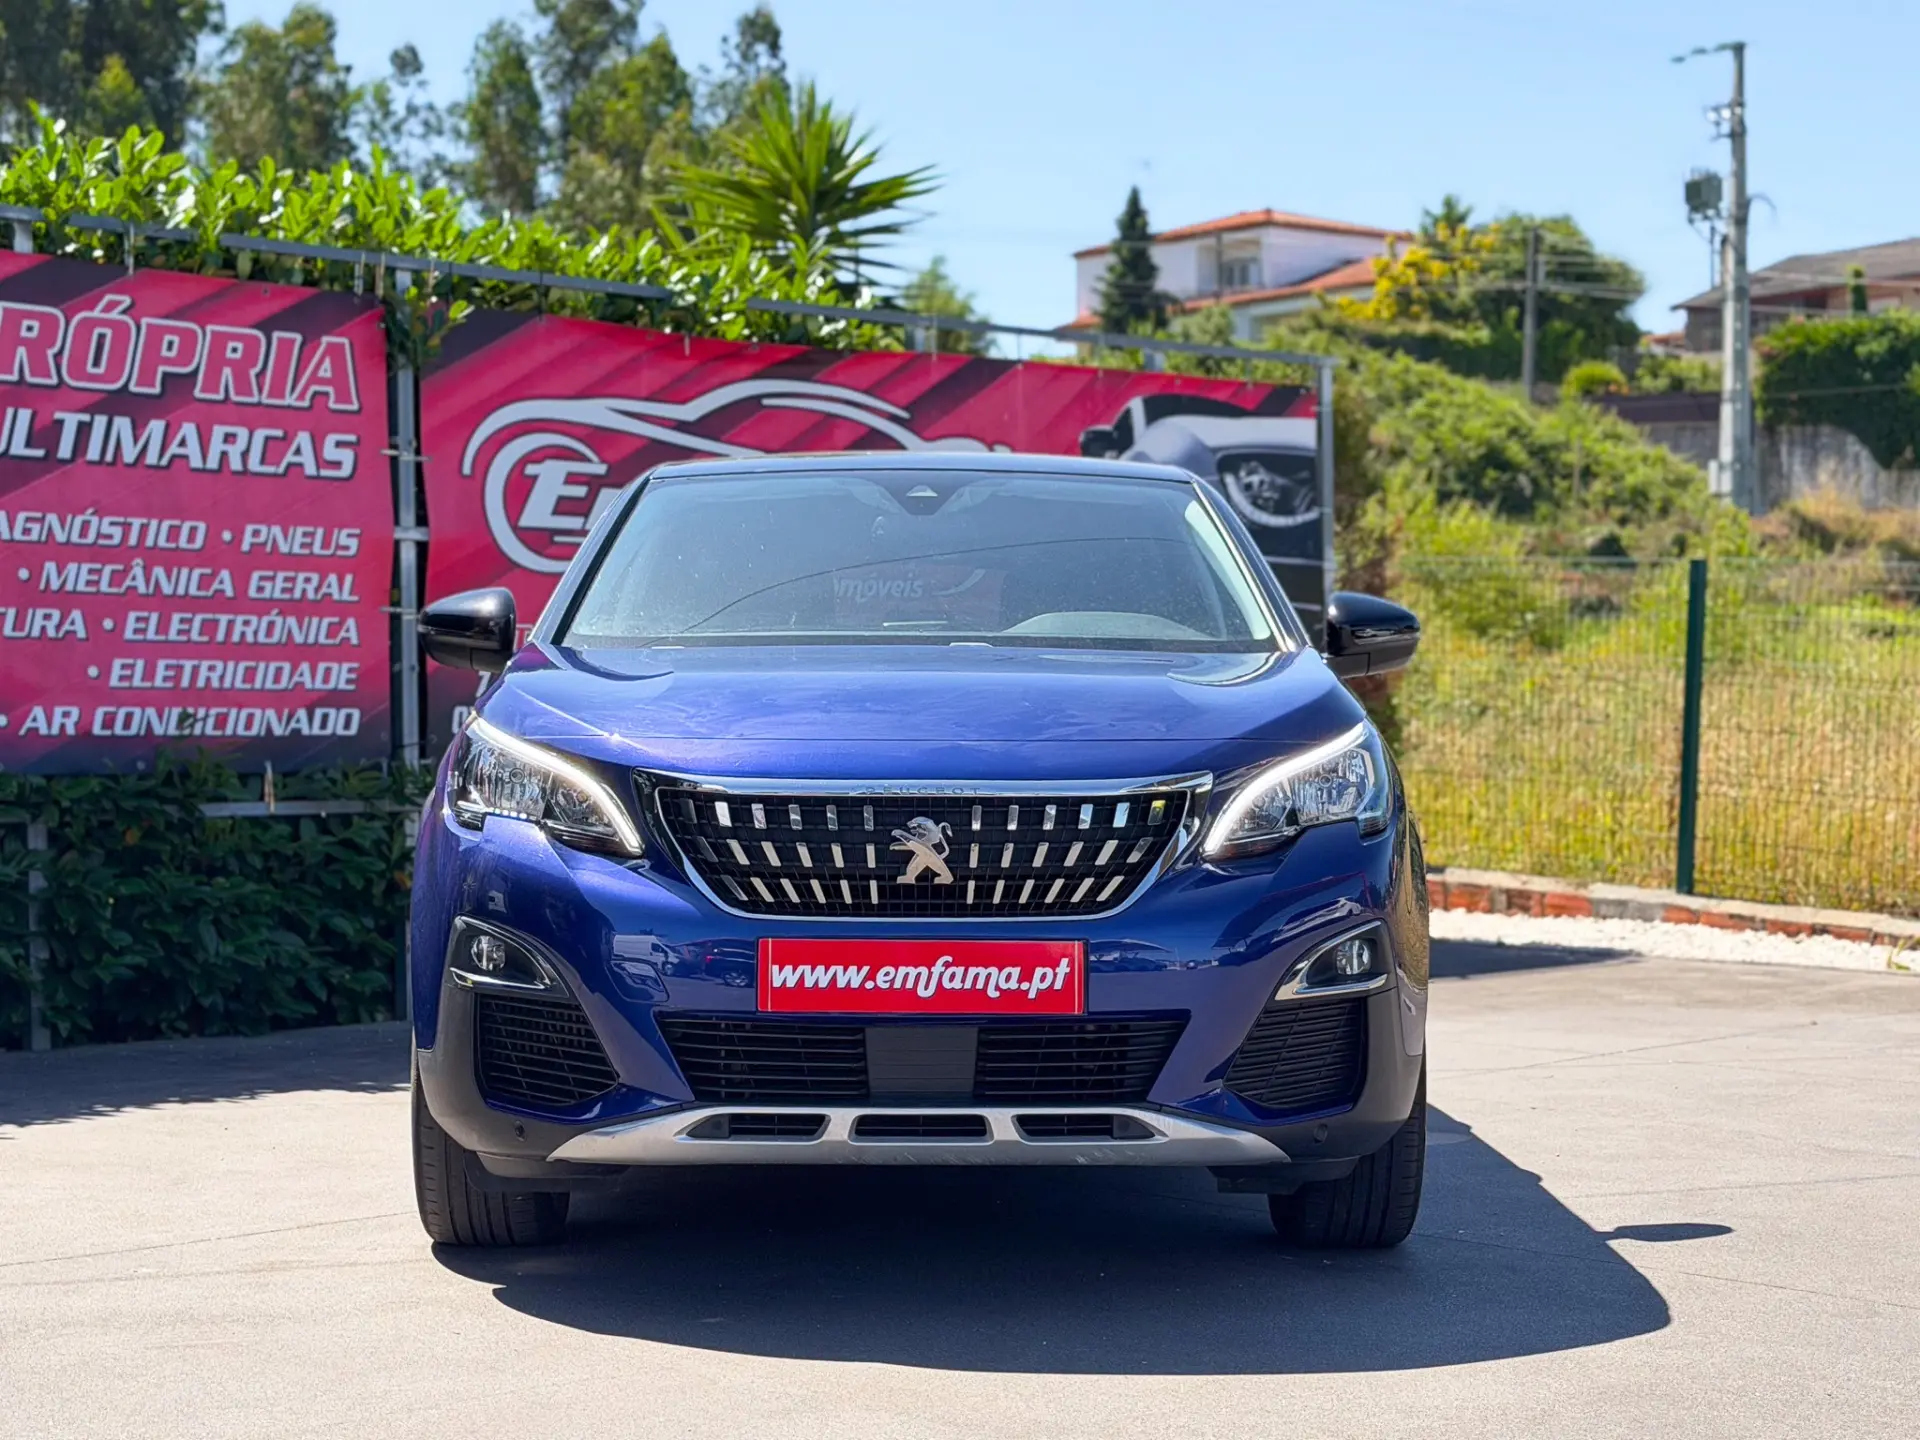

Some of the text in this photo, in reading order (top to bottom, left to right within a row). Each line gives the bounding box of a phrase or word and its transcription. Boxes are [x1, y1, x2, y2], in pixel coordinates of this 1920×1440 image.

[241, 523, 361, 557] PNEUS
[39, 558, 360, 602] MECÂNICA GERAL
[0, 606, 360, 646] URA ELECTRÓNICA
[109, 657, 360, 690] ELETRICIDADE
[18, 705, 361, 737] AR CONDICIONADO
[771, 955, 1071, 999] www.emfama.pt
